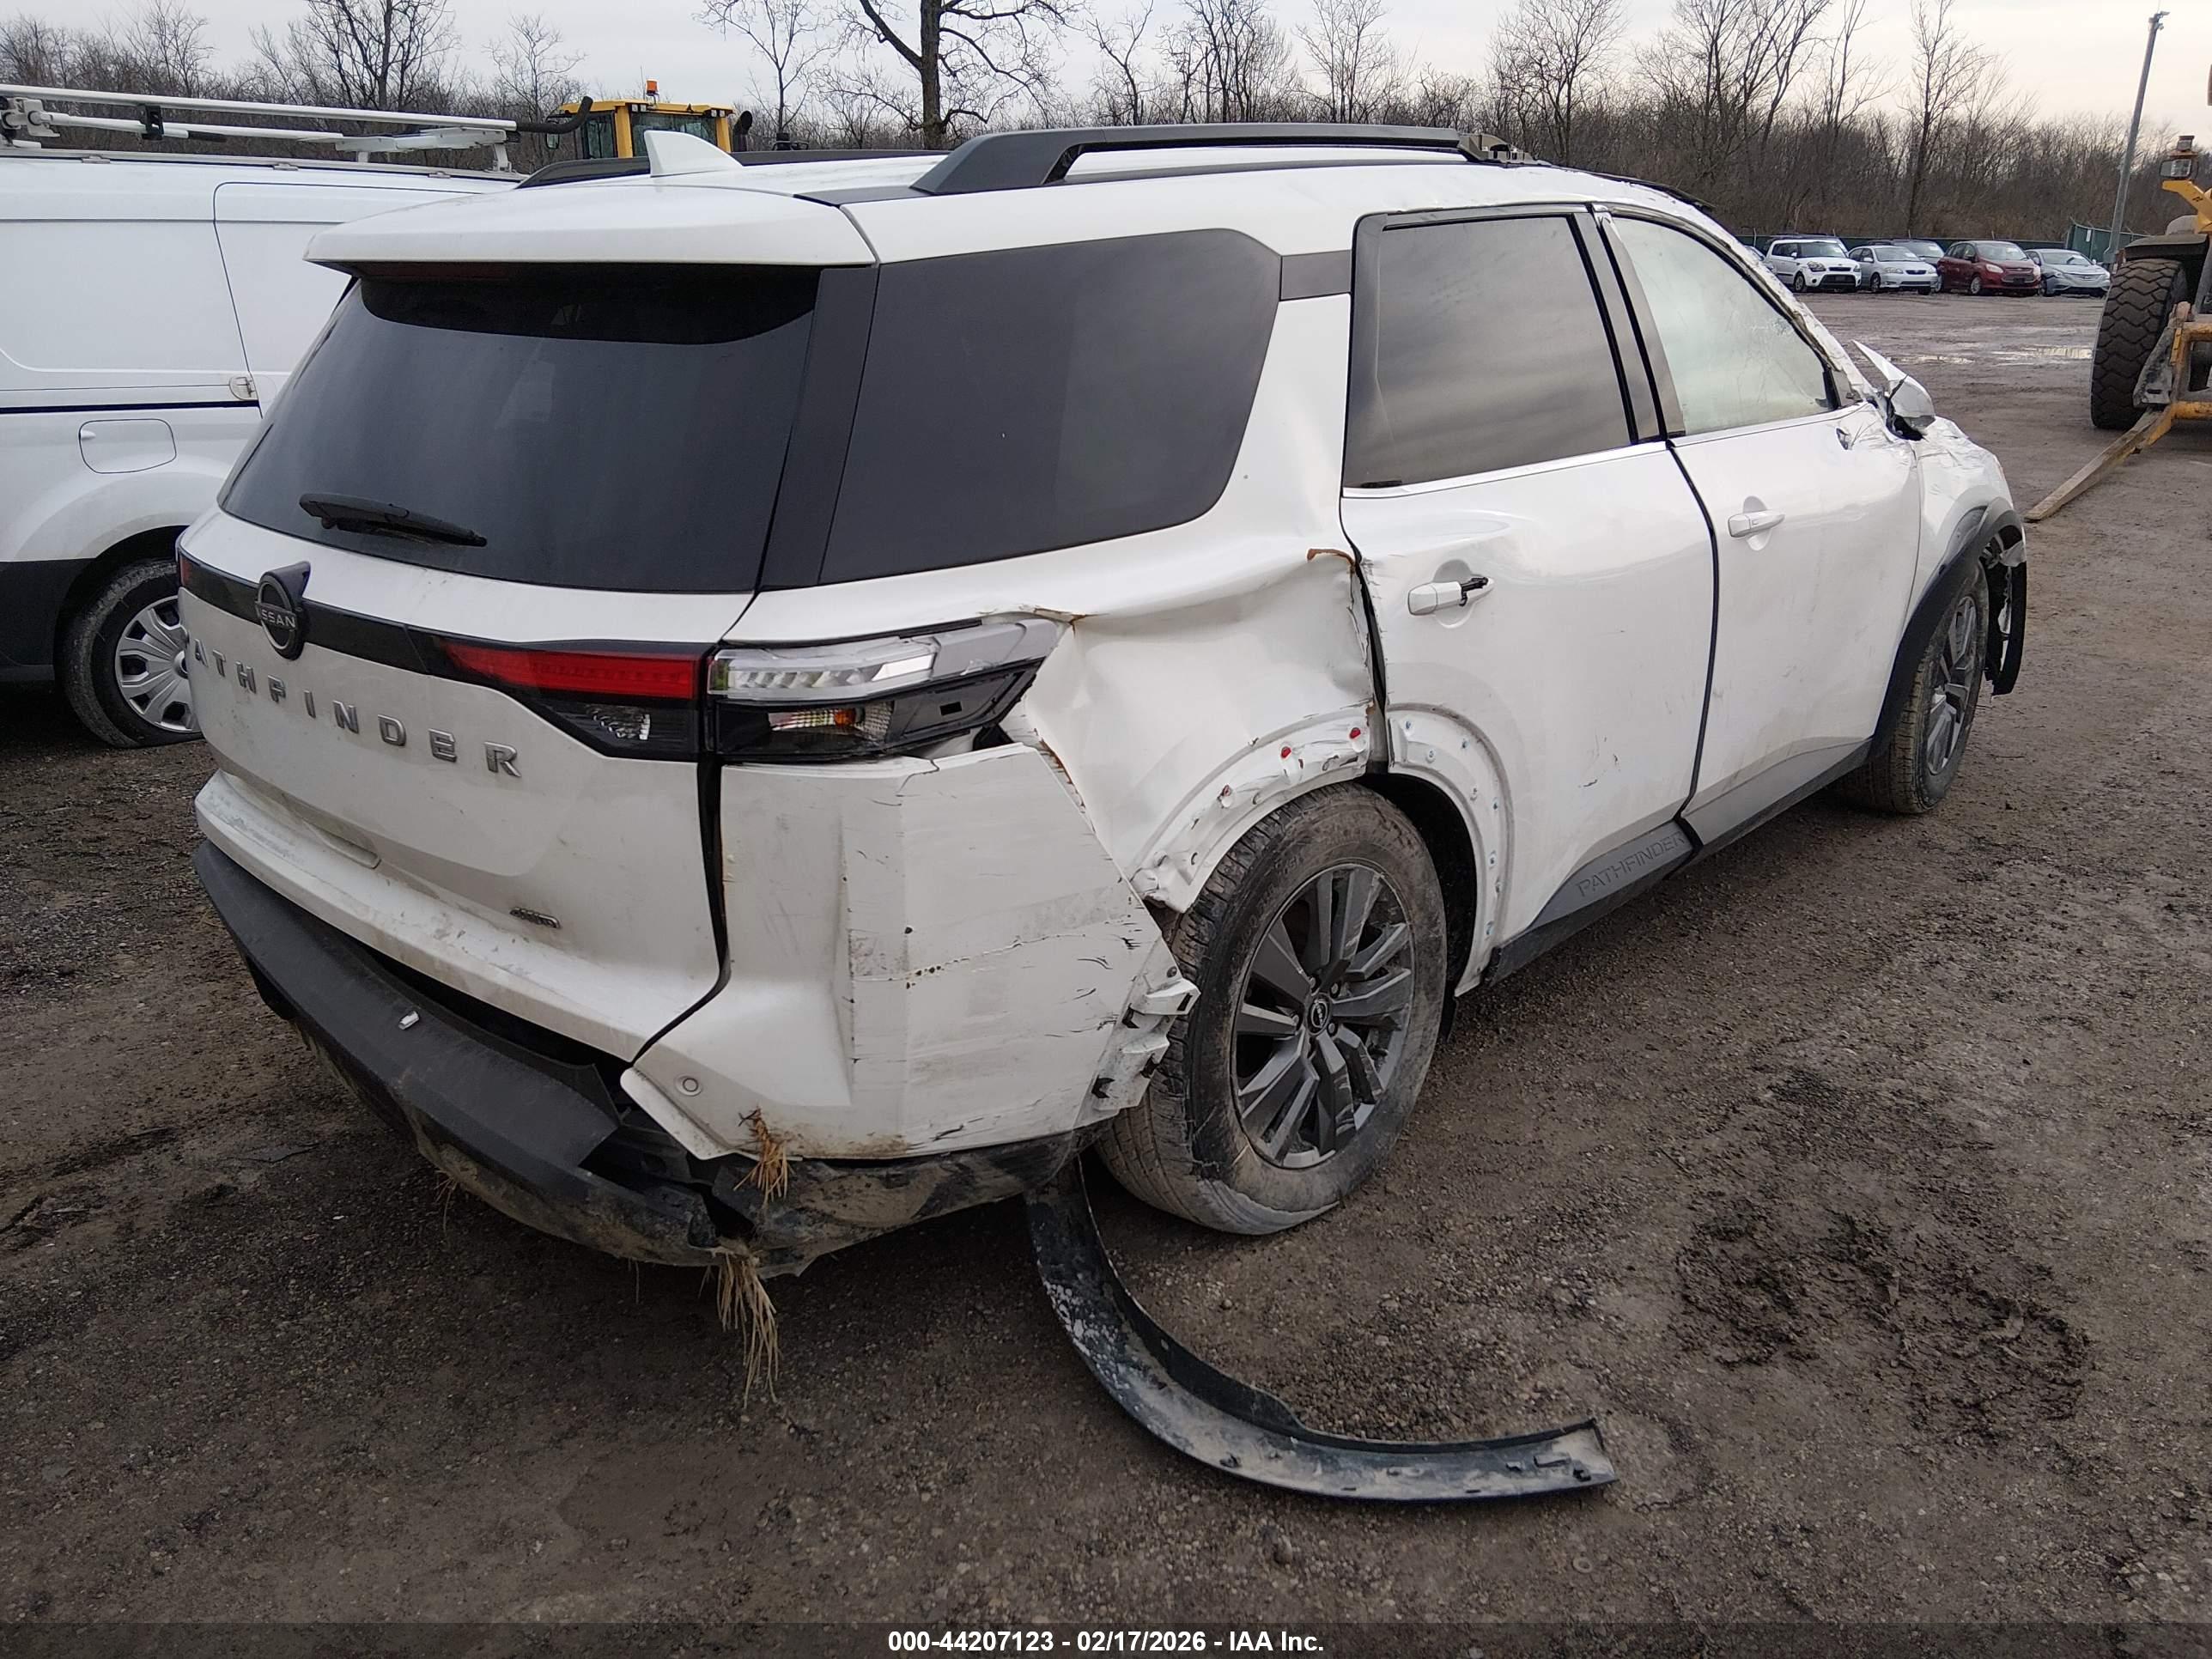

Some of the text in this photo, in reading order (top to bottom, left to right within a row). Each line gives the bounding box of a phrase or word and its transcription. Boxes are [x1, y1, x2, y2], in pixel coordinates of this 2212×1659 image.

[260, 608, 296, 628] SSAN
[192, 638, 523, 778] ATHFINDER
[1577, 830, 1686, 897] PATHFINDER
